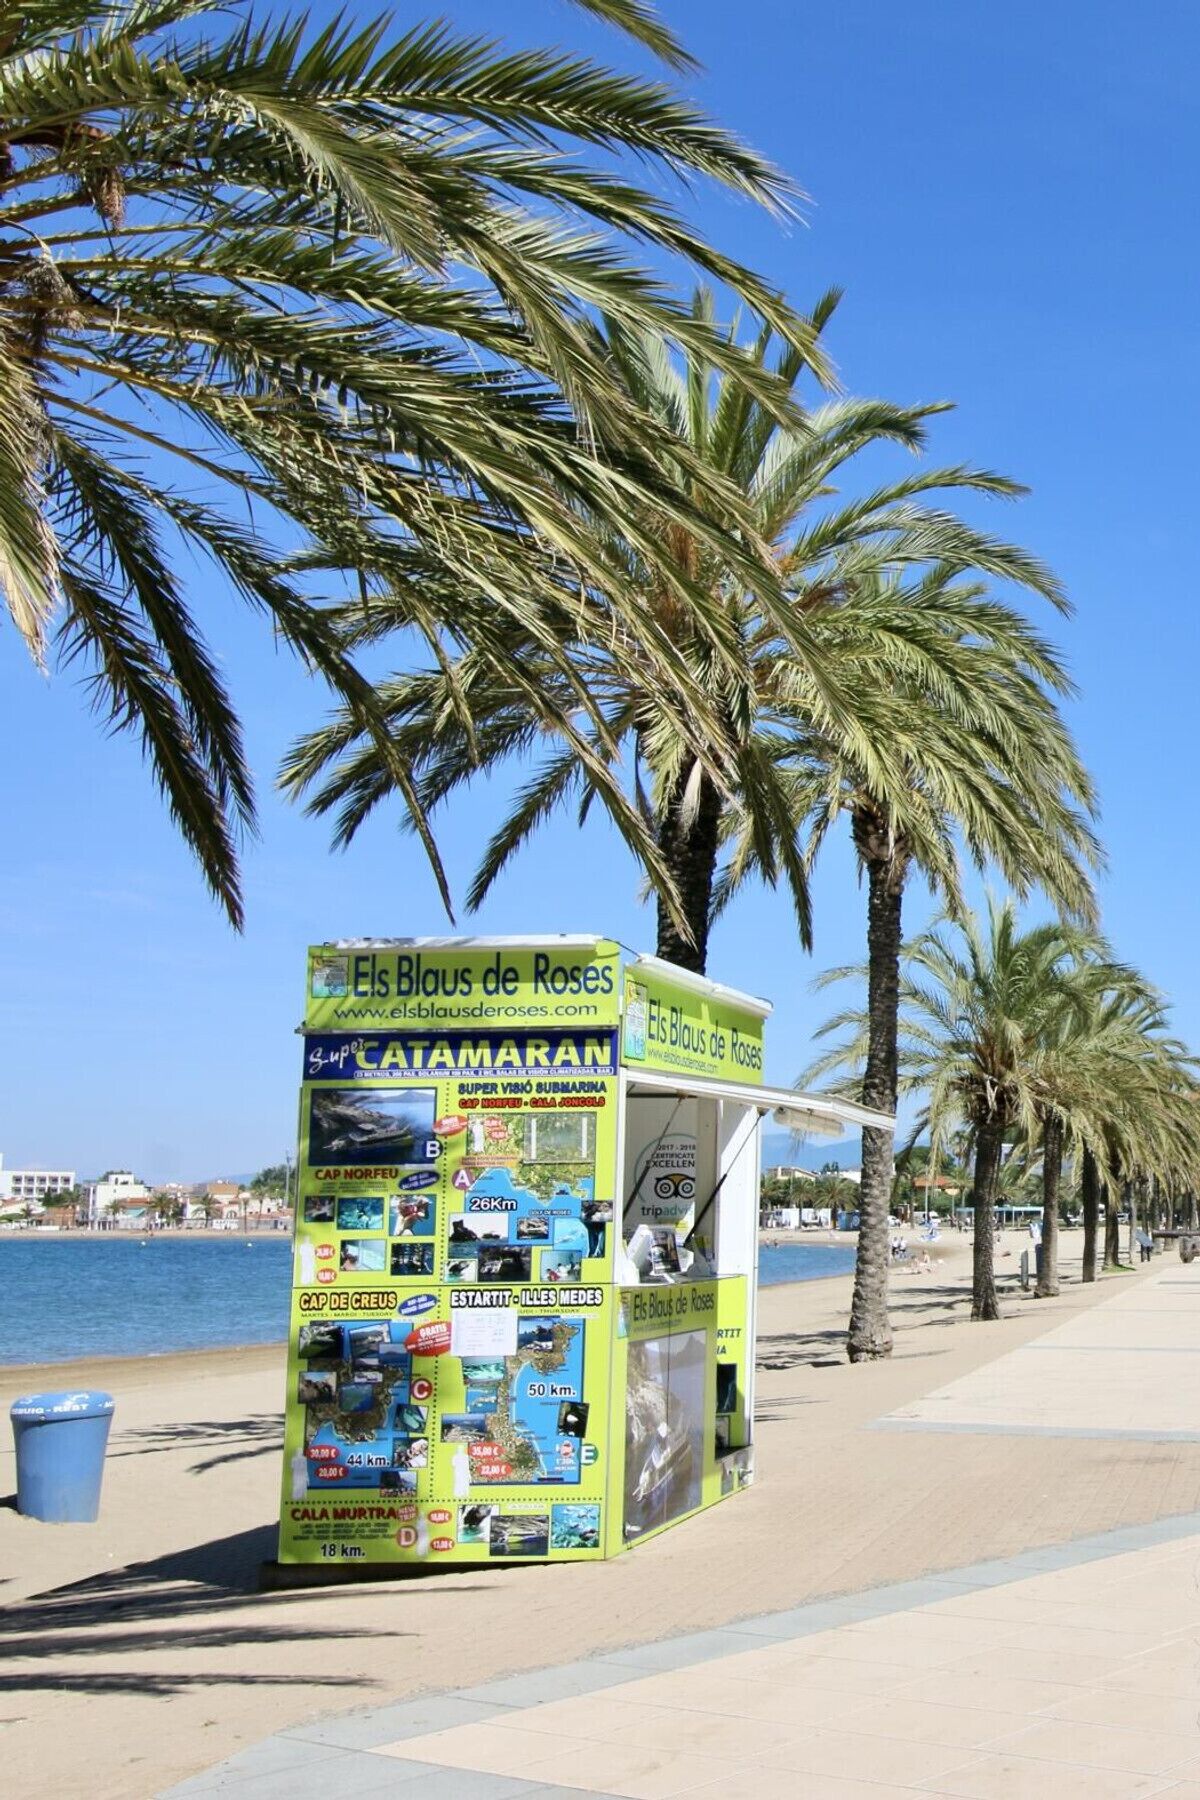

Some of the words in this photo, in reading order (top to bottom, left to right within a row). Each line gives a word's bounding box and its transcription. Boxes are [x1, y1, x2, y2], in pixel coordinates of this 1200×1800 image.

[353, 953, 389, 998] Els
[396, 953, 473, 997] Blaus
[482, 952, 519, 996] de
[534, 952, 613, 995] Roses
[333, 1002, 598, 1019] www.elsblausderoses.com
[648, 998, 667, 1043] Els
[669, 1006, 706, 1055] Blaus
[709, 1019, 725, 1060] de
[731, 1027, 762, 1071] Roses
[309, 1037, 365, 1074] Super
[355, 1038, 611, 1070] CATAMARAN
[458, 1083, 498, 1095] SUPER
[501, 1080, 533, 1094] VISIÓ
[535, 1081, 607, 1093] SUBMARINA
[459, 1099, 479, 1109] CAP
[481, 1098, 522, 1108] NORFEU
[529, 1098, 557, 1108] CALA
[426, 1141, 441, 1158] B
[315, 1169, 340, 1179] CAP
[344, 1168, 398, 1178] NORFEU
[455, 1169, 470, 1187] A
[470, 1197, 517, 1212] 26Km
[300, 1293, 328, 1310] CAP
[330, 1293, 349, 1309] DE
[351, 1291, 397, 1309] CREUS
[450, 1290, 512, 1307] ESTARTIT
[520, 1289, 558, 1306] ILLES
[559, 1288, 603, 1306] MEDES
[420, 1323, 447, 1339] GRATIS
[413, 1382, 429, 1399] C
[529, 1384, 545, 1396] 50
[550, 1384, 576, 1396] km.
[347, 1454, 362, 1466] 44
[367, 1453, 390, 1467] km.
[581, 1446, 595, 1464] E
[291, 1508, 330, 1521] CALA
[332, 1507, 398, 1520] MURTRA
[401, 1528, 416, 1546] D
[320, 1544, 336, 1556] 18
[340, 1544, 365, 1556] km.
